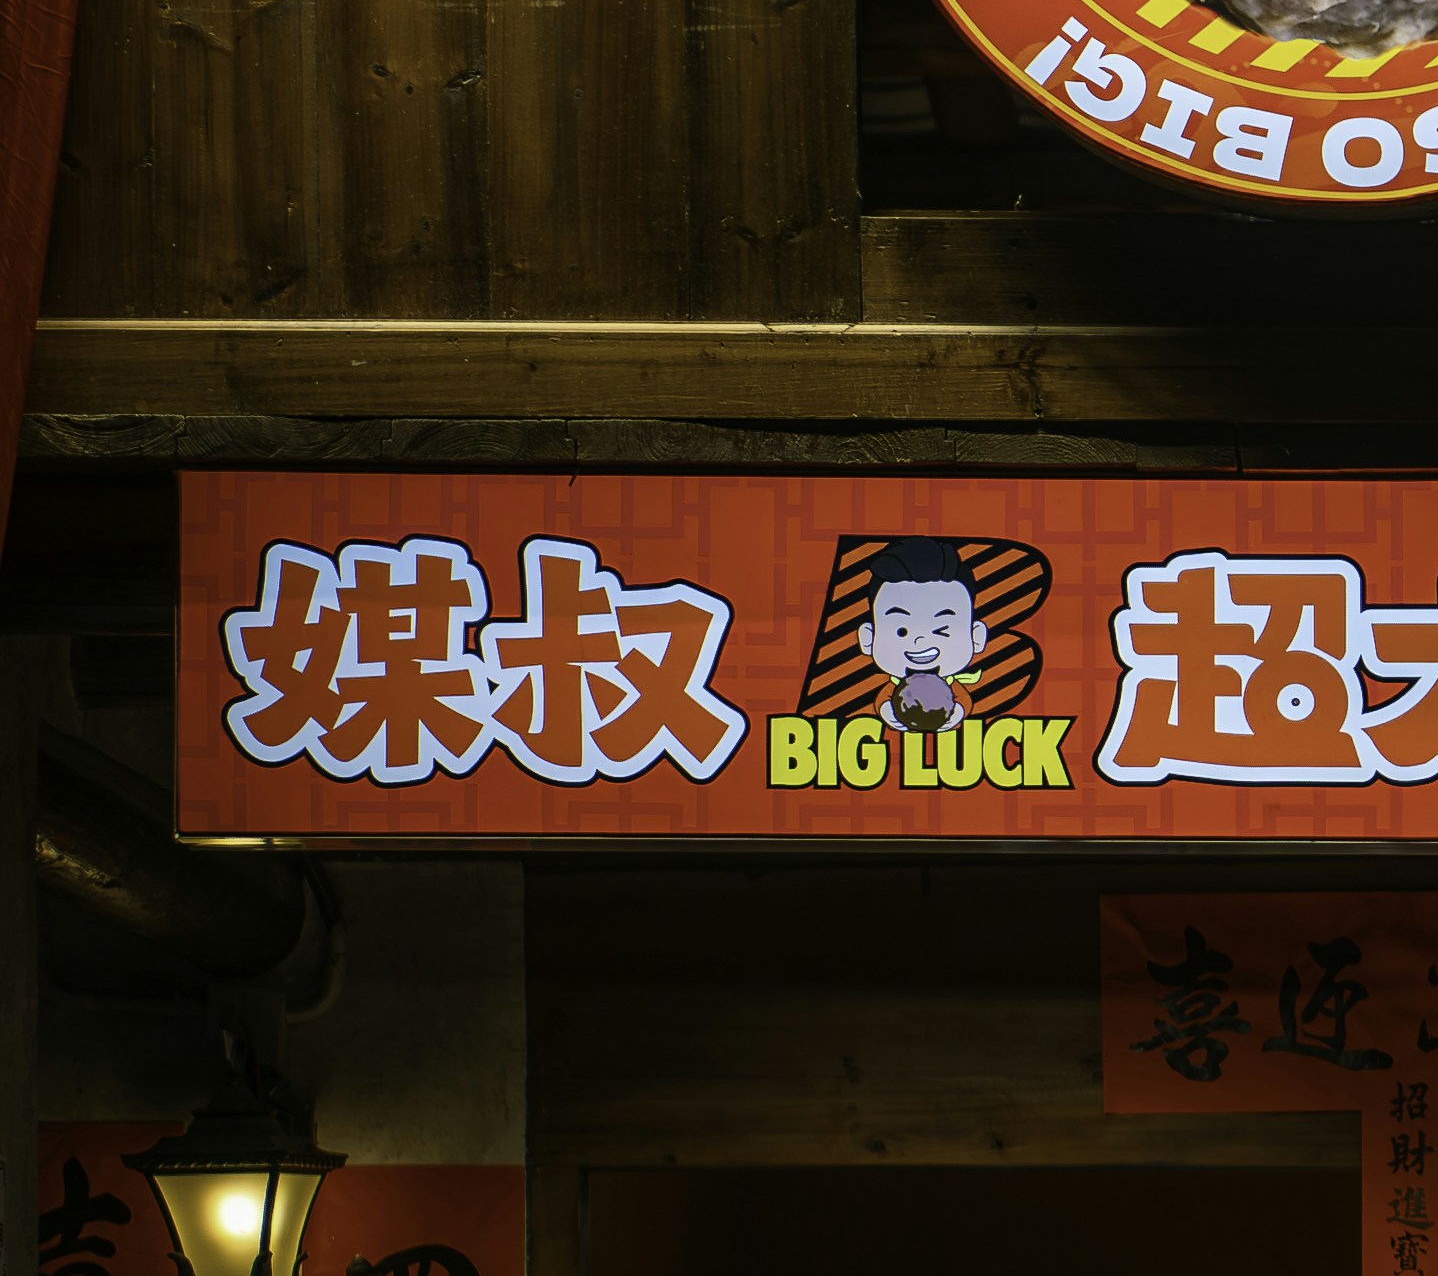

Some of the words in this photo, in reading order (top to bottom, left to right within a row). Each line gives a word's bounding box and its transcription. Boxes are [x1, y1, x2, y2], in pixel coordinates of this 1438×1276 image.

[1025, 17, 1294, 182] BIG!
[222, 533, 749, 788] 媒叔
[767, 717, 895, 789] BIG
[900, 717, 1077, 789] LUCK
